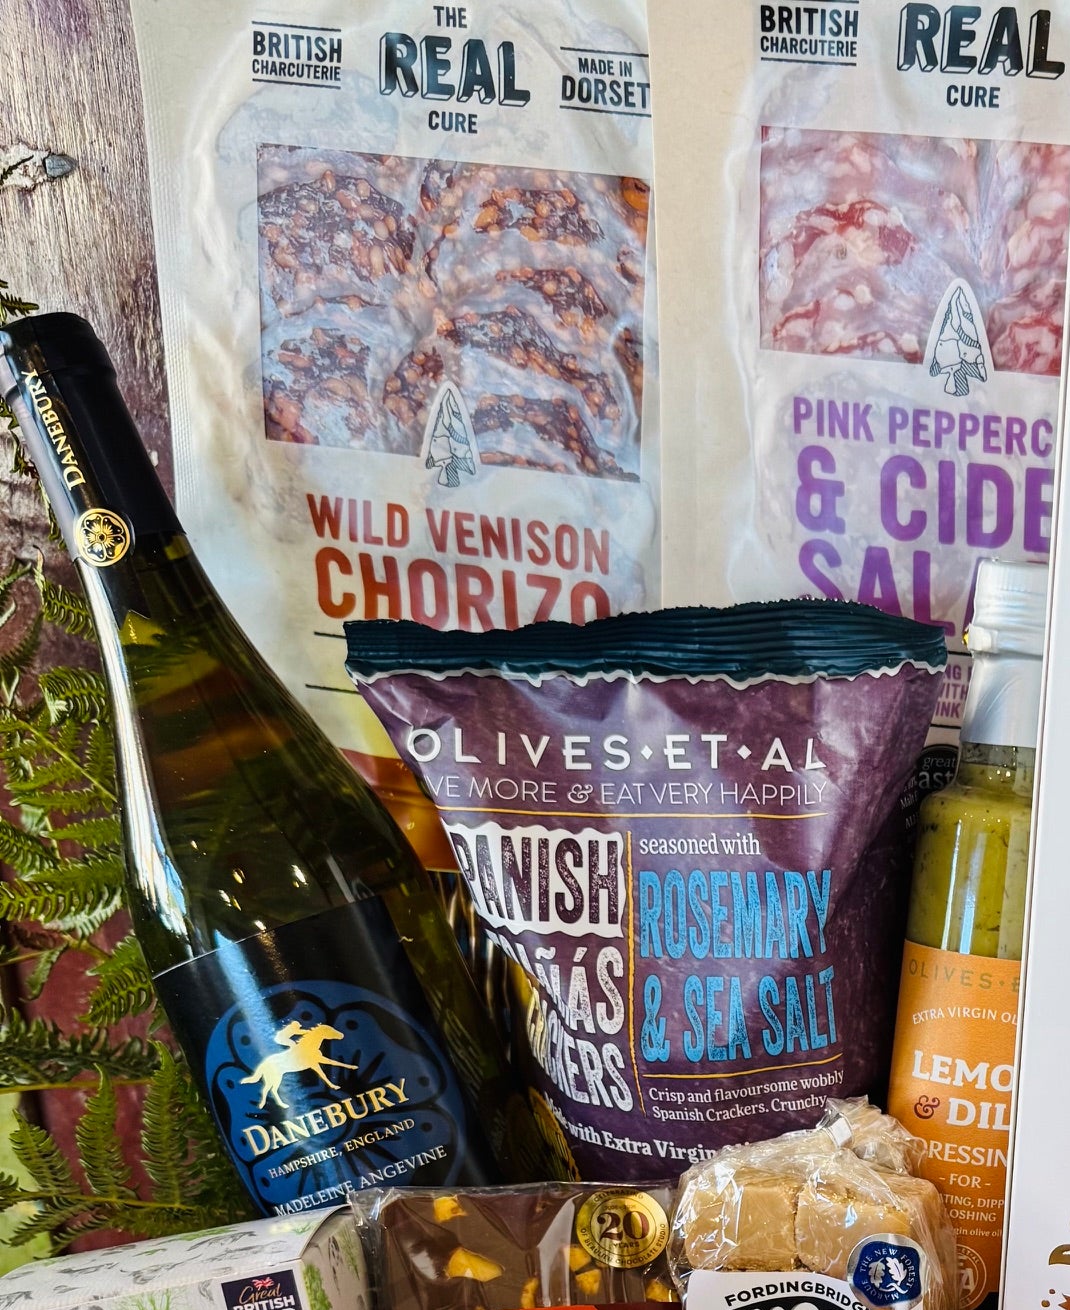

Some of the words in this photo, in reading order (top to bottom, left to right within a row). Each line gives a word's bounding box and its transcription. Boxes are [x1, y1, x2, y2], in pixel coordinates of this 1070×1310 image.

[435, 7, 466, 28] THE
[761, 5, 858, 37] BRITISH
[253, 31, 341, 62] BRITISH
[760, 36, 857, 59] CHARCUTERIE
[898, 3, 1065, 80] REAL
[252, 59, 341, 82] CHARCUTERIE
[379, 32, 530, 107] REAL
[562, 75, 650, 108] DORSET
[946, 85, 999, 108] CURE
[429, 111, 477, 134] CURE
[21, 369, 86, 491] DANEBURY
[793, 396, 871, 442] PINK
[795, 445, 845, 535] &
[307, 494, 409, 548] WILD
[426, 509, 610, 575] VENISON
[468, 778, 557, 803] MORE
[720, 781, 827, 807] HAPPILY
[639, 834, 719, 856] seasoned
[639, 868, 832, 960] ROSEMARY
[640, 974, 667, 1064] &
[683, 977, 751, 1063] SEA
[761, 968, 839, 1060] SALT
[913, 1008, 945, 1025] EXTRA
[948, 1007, 998, 1020] VIRGIN
[649, 1087, 685, 1104] Crisp
[687, 1090, 711, 1103] and
[714, 1078, 798, 1102] flavoursome
[800, 1069, 844, 1090] wobbly
[240, 1077, 411, 1157] DANEBURY
[653, 1106, 703, 1121] Spanish
[706, 1102, 769, 1122] Crackers.
[268, 1144, 343, 1180] HAMPSHIRE,
[344, 1118, 416, 1153] ENGLAND
[601, 1131, 651, 1156] Extra
[274, 1179, 355, 1217] MADELEINE
[359, 1144, 447, 1190] ANGEVINE
[597, 1211, 650, 1241] 20
